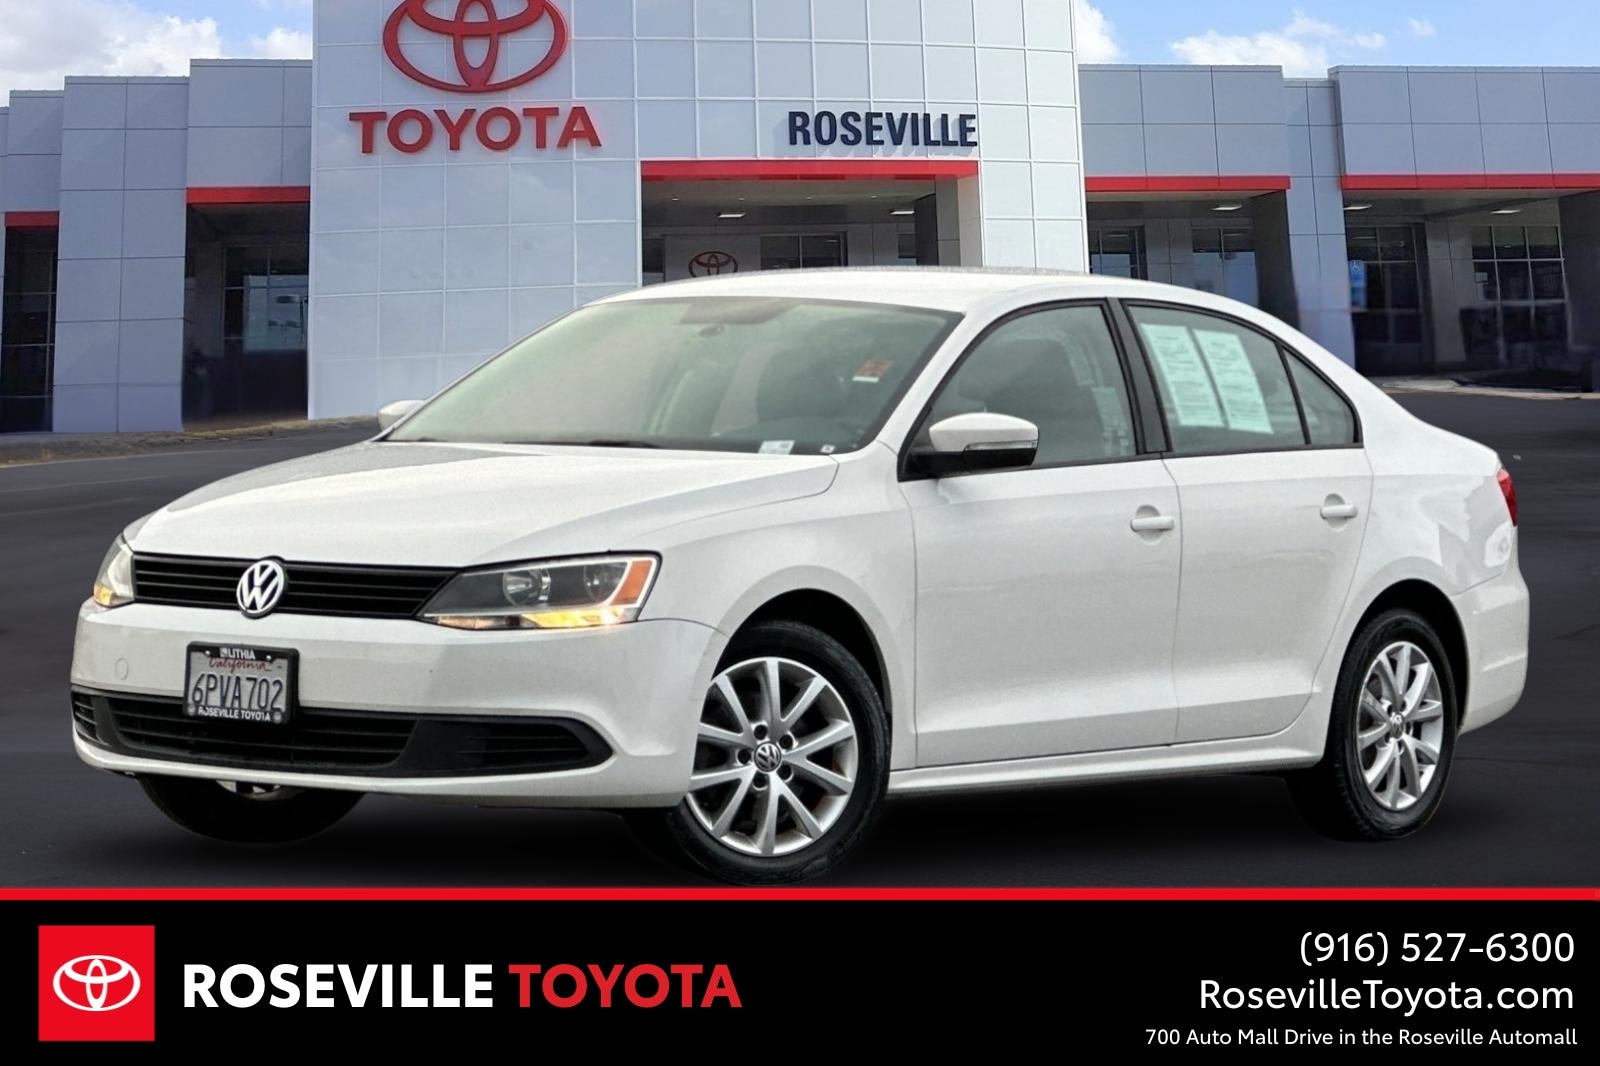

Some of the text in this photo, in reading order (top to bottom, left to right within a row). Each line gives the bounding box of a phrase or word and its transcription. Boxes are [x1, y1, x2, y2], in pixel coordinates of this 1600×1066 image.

[349, 106, 602, 154] TOYOTA
[788, 110, 978, 148] ROSEVILLE
[209, 657, 272, 673] California
[228, 648, 256, 660] LITHIA
[192, 673, 283, 711] 6PVA702
[198, 706, 271, 722] ROSEVILLE TOYOTA
